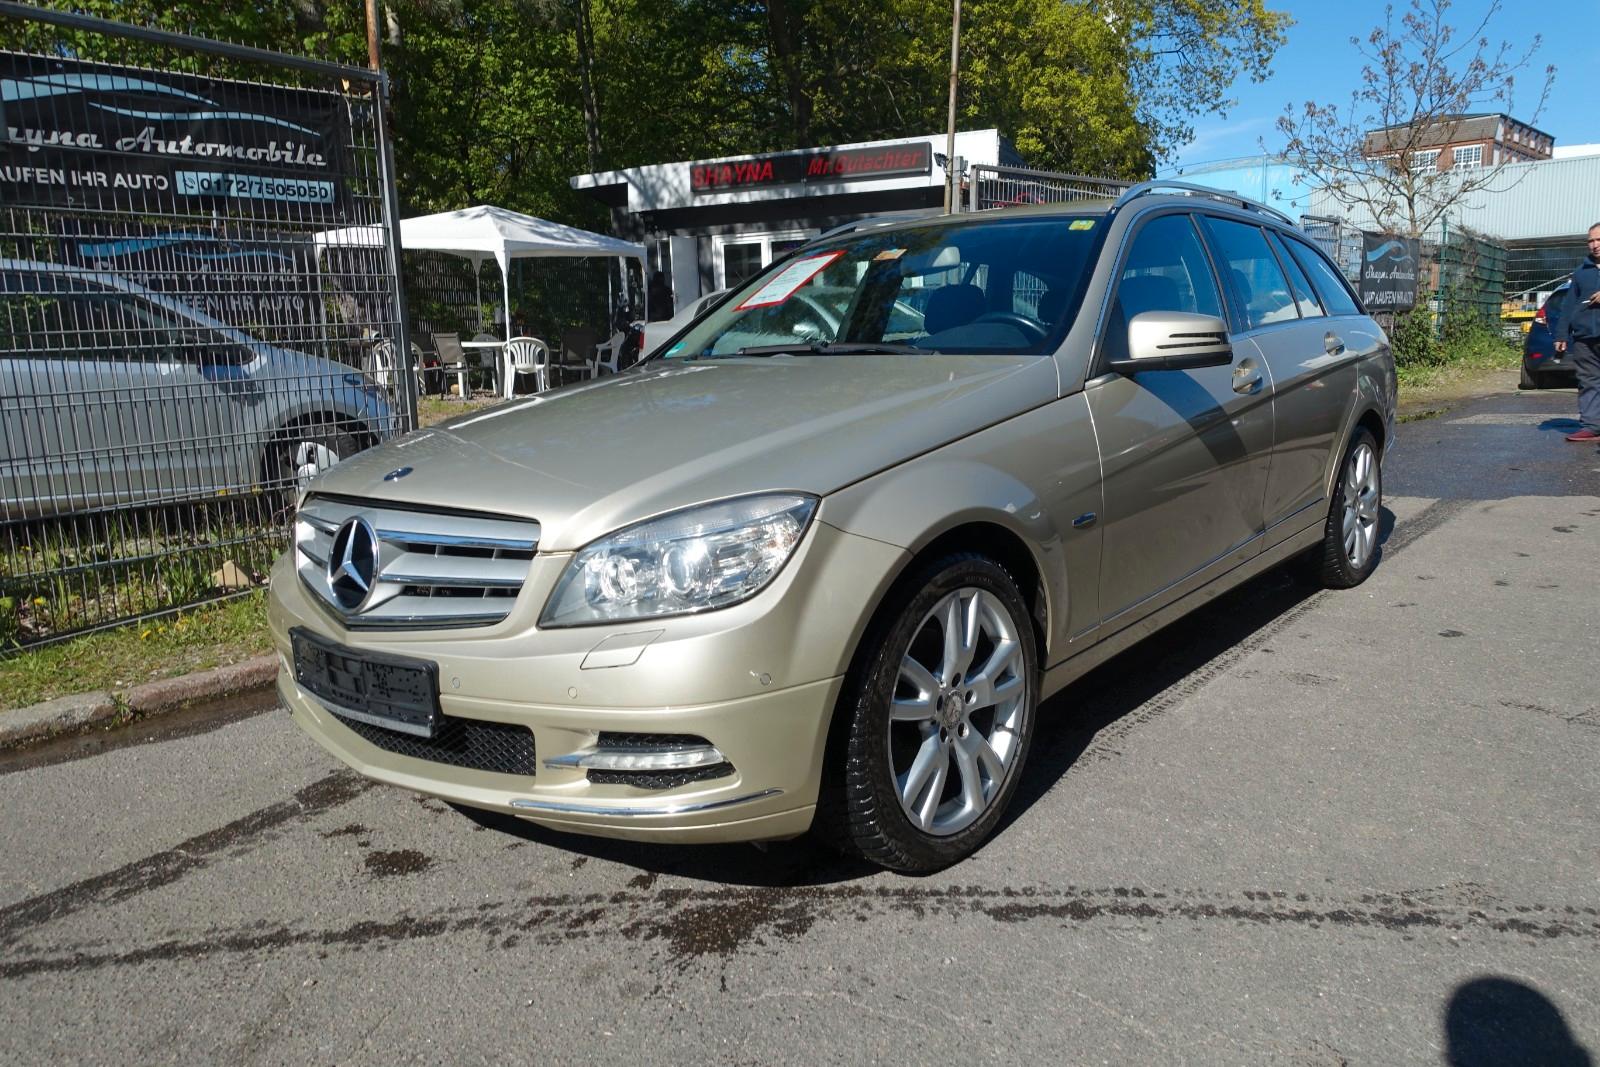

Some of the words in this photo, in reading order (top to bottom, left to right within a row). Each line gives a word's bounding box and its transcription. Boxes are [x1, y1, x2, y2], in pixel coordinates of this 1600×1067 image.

[115, 126, 327, 167] Automobile
[71, 169, 109, 188] IHR
[114, 173, 169, 191] AUTO
[200, 178, 329, 200] 0172/7505050
[692, 160, 774, 188] SHAYNA
